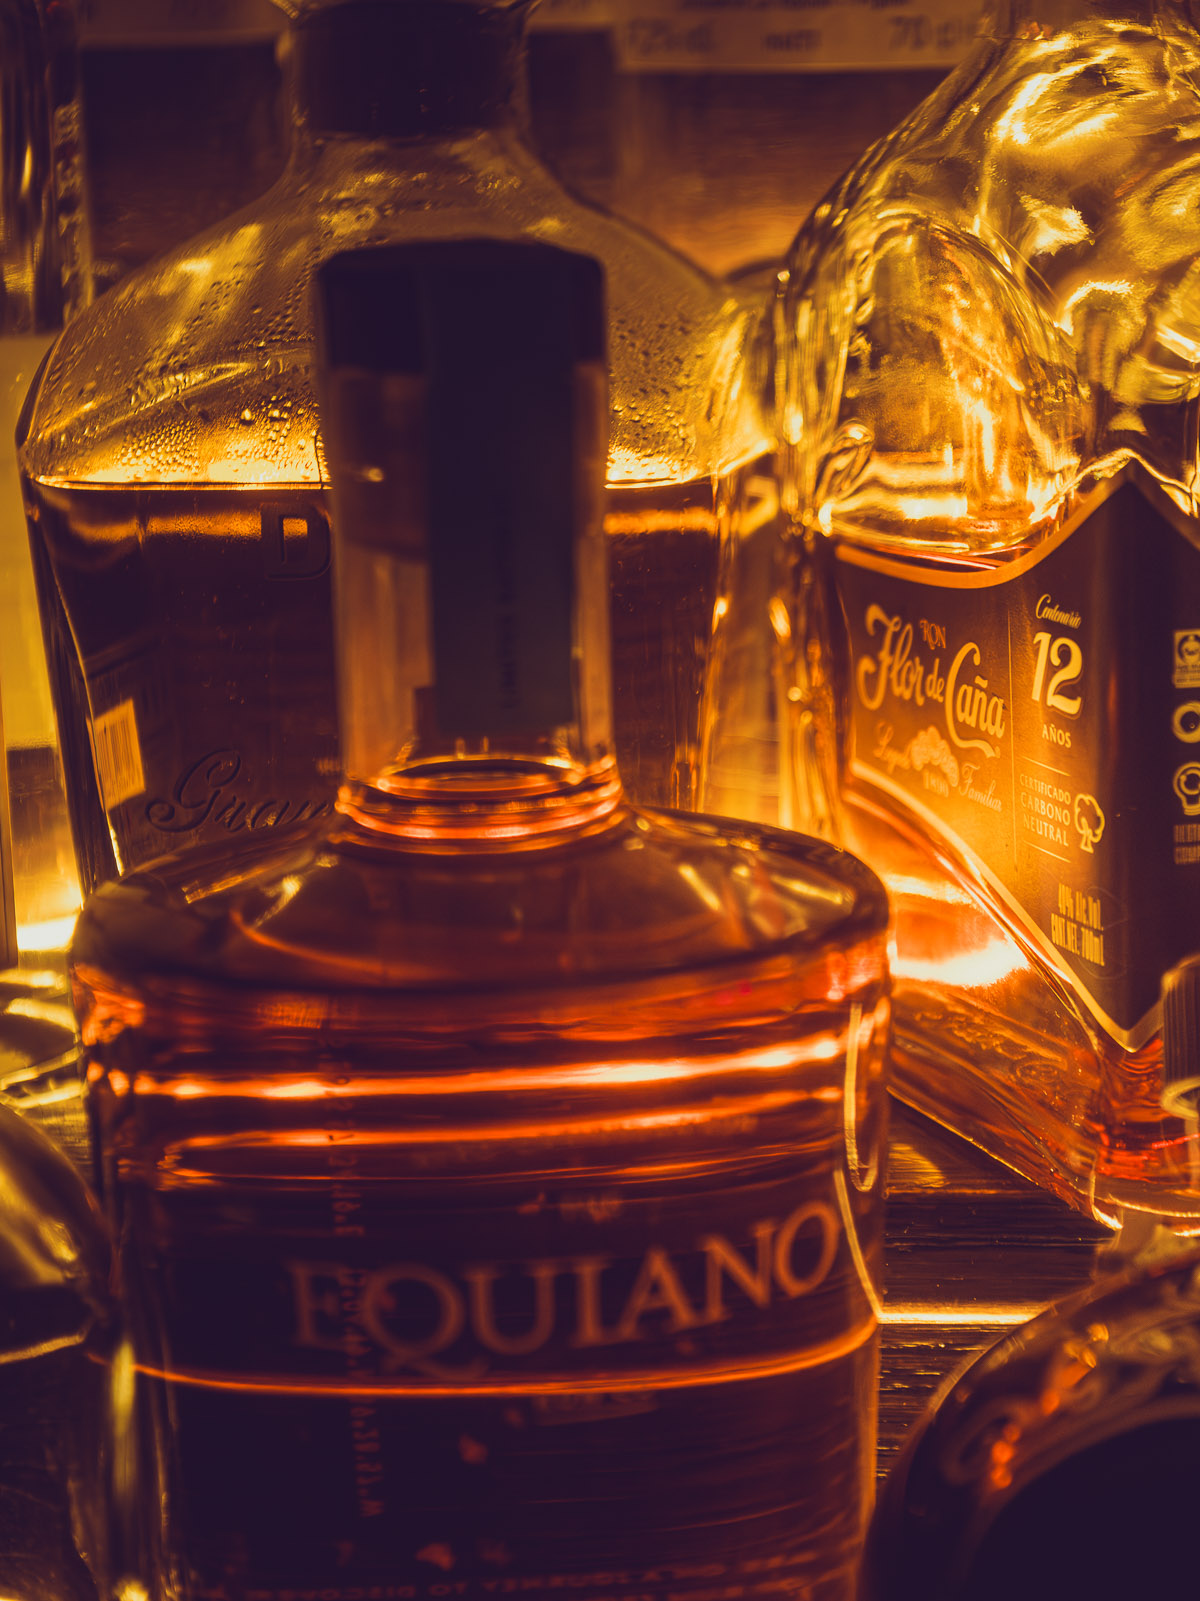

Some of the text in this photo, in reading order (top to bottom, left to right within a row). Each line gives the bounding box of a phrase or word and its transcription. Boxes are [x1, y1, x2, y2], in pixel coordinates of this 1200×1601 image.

[1035, 593, 1082, 629] Centenario
[856, 603, 1006, 759] Flor de Caña
[1031, 631, 1083, 716] 12
[1041, 723, 1072, 749] AÑOS
[1019, 773, 1072, 805] CERTIFICADO
[1020, 791, 1071, 826] CARBONO
[1023, 813, 1069, 847] NEUTRAL
[283, 1200, 840, 1383] EQUIANO
